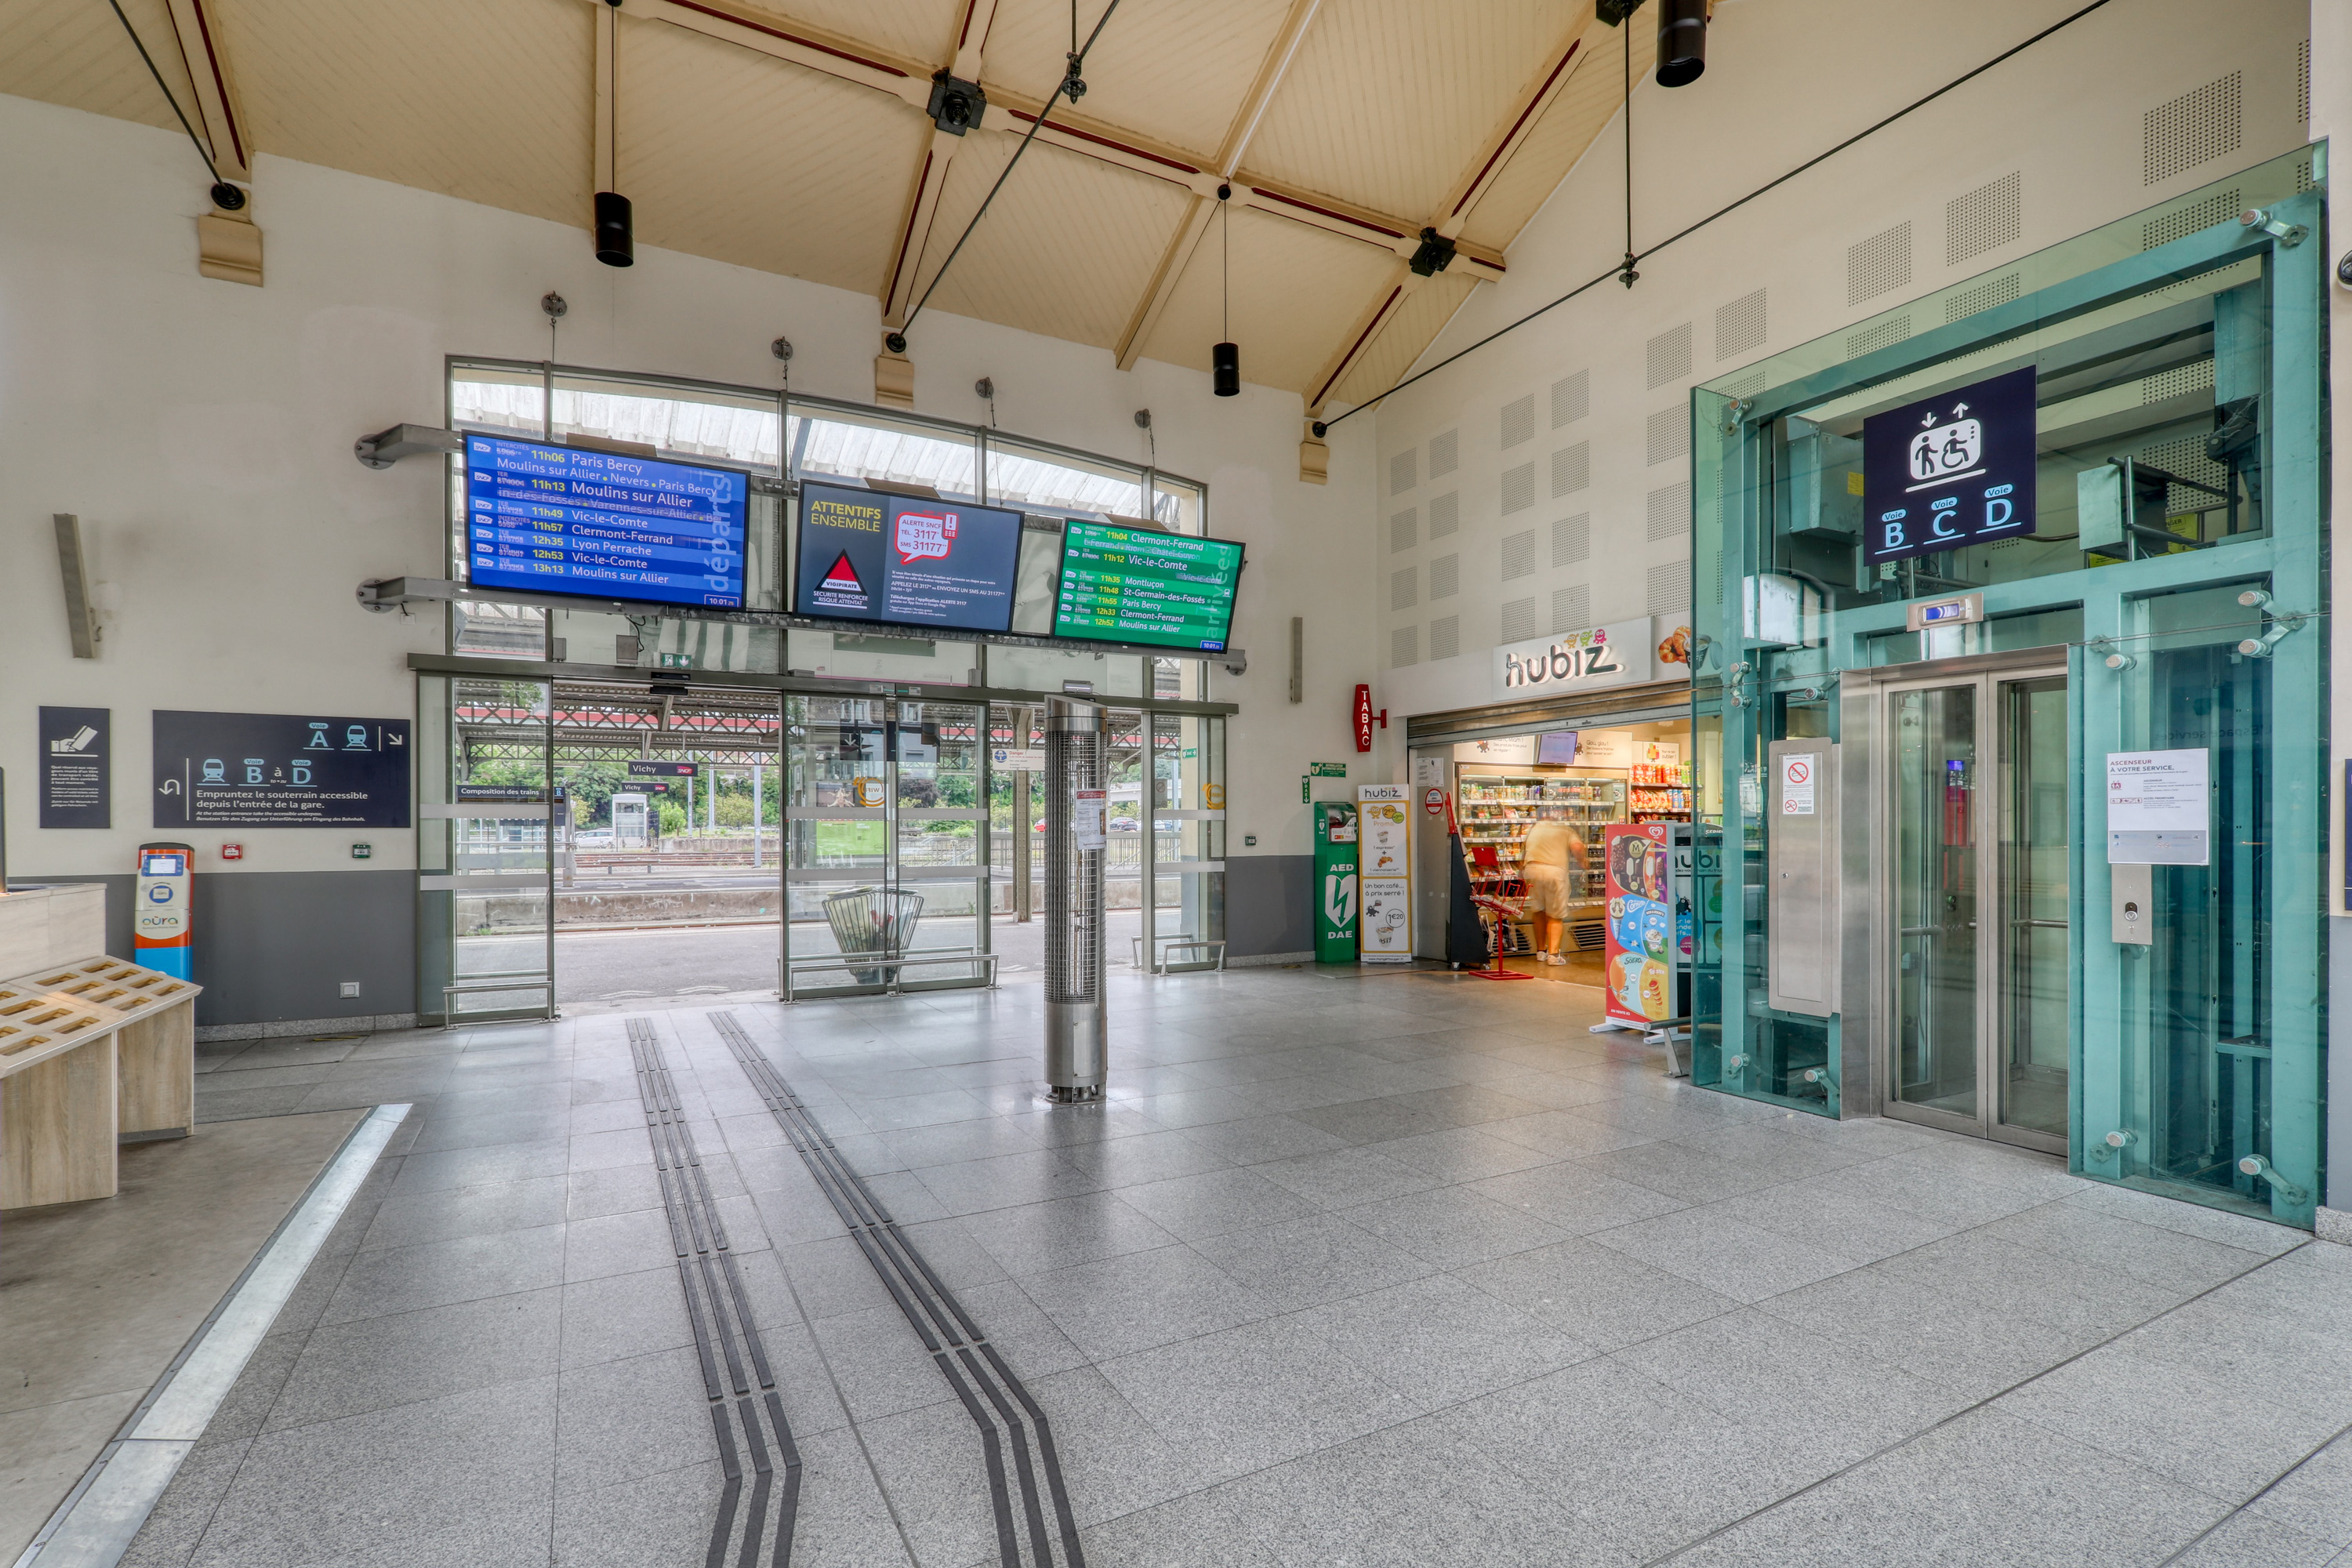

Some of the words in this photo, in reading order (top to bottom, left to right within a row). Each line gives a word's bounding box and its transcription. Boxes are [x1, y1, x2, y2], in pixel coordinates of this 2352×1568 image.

[532, 451, 564, 463] 11h06
[572, 453, 603, 468] Paris
[607, 459, 642, 475] Bercy
[497, 458, 545, 473] Moulins
[549, 467, 567, 476] sur
[570, 468, 601, 480] Allier
[611, 474, 648, 487] Nevers
[659, 480, 684, 492] Paris
[688, 484, 717, 497] Bercy
[532, 480, 565, 492] 11h13
[572, 481, 628, 499] Moulins
[632, 492, 653, 502] sur
[657, 493, 692, 507] Allier
[1988, 486, 2009, 496] Voie
[811, 501, 881, 519] ATTENTIFS
[1935, 499, 1954, 508] Voie
[532, 507, 563, 517] 11h49
[572, 510, 648, 528] Vic-le-Comte
[1885, 511, 1903, 520] Voie
[1987, 499, 2013, 527] D
[811, 514, 880, 532] ENSEMBLE
[1933, 510, 1957, 536] C
[532, 521, 563, 532] 11h57
[572, 524, 673, 544] Clermont-Ferrand
[703, 476, 737, 592] départs
[1107, 531, 1127, 540] 11h04
[1131, 533, 1203, 551] Clermont-Ferrand
[1886, 521, 1904, 547] B
[532, 535, 564, 546] 12h35
[572, 539, 600, 550] Lyon
[603, 541, 652, 556] Perrache
[533, 550, 564, 560] 12h53
[572, 552, 648, 568] Vic-le-Comte
[1104, 554, 1125, 563] 11h12
[1129, 554, 1188, 571] Vic-le-Comte
[533, 564, 564, 573] 13h13
[572, 566, 617, 579] Moulins
[620, 571, 637, 581] sur
[640, 572, 669, 584] Allier
[1101, 575, 1120, 583] 11h35
[1125, 576, 1164, 589] Montluçon
[1099, 586, 1119, 594] 11h48
[1123, 588, 1205, 604] St-Germain-des-Fossés
[1122, 598, 1139, 607] Paris
[1142, 600, 1161, 611] Bercy
[1120, 609, 1185, 623] Clermont-Ferrand
[1119, 619, 1147, 630] Moulins
[1161, 624, 1180, 633] Allier
[1506, 644, 1618, 688] hubiz
[1361, 691, 1370, 746] TABAC
[310, 731, 328, 746] A
[247, 767, 263, 783] B
[274, 768, 281, 777] à
[293, 768, 311, 784] D
[633, 765, 656, 774] Vichy
[197, 790, 252, 800] Empruntez
[267, 791, 317, 800] souterrain
[320, 792, 368, 800] accessible
[1365, 788, 1402, 797] hubiz
[197, 800, 230, 809] depuis
[143, 916, 178, 925] oùra
[1388, 913, 1403, 924] 1€20
[1327, 931, 1352, 939] DAE
